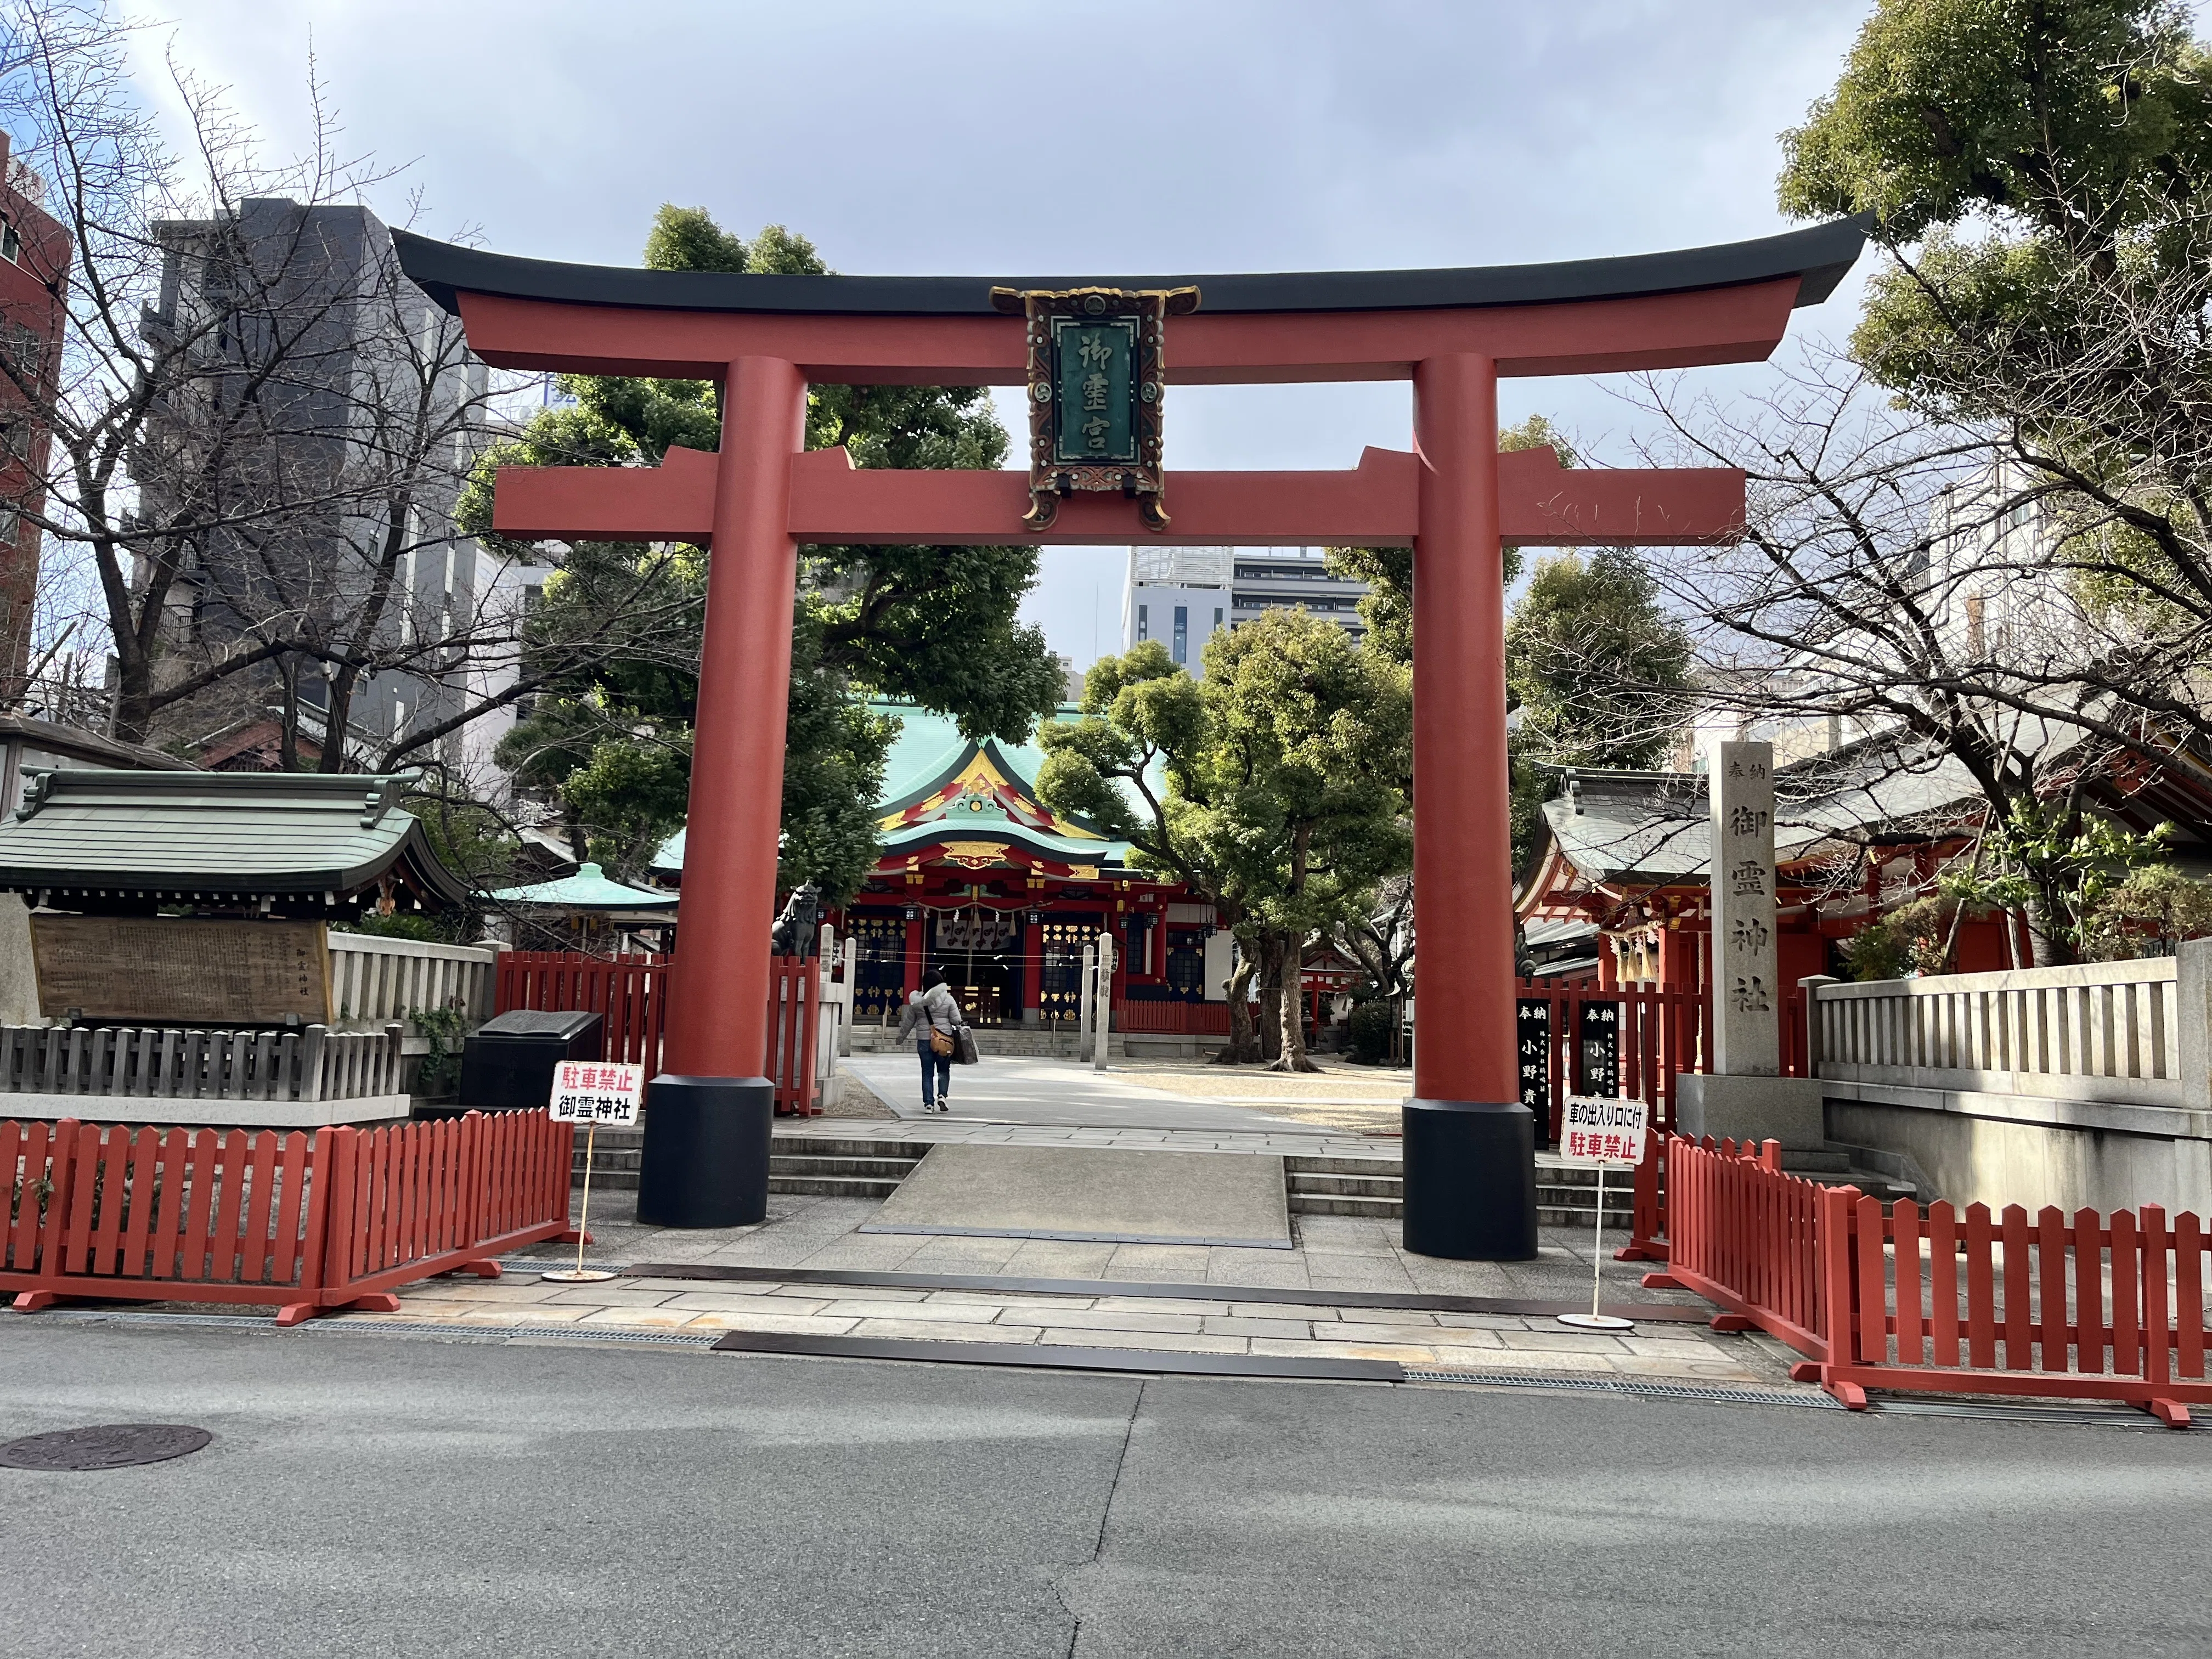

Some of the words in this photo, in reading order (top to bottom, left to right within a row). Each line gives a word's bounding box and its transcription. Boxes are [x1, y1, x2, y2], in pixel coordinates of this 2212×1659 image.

[1729, 761, 1765, 781] 奉納
[1730, 806, 1769, 1013] 御霊神社
[1519, 1006, 1546, 1019] 奉納
[1587, 1008, 1614, 1022] 奉納
[562, 1066, 633, 1091] 駐車禁止
[1522, 1040, 1538, 1121] 小野貴
[559, 1095, 630, 1120] 御霊神社
[1570, 1102, 1641, 1129] 車の出入り口に付
[1569, 1132, 1636, 1159] 駐車禁止
